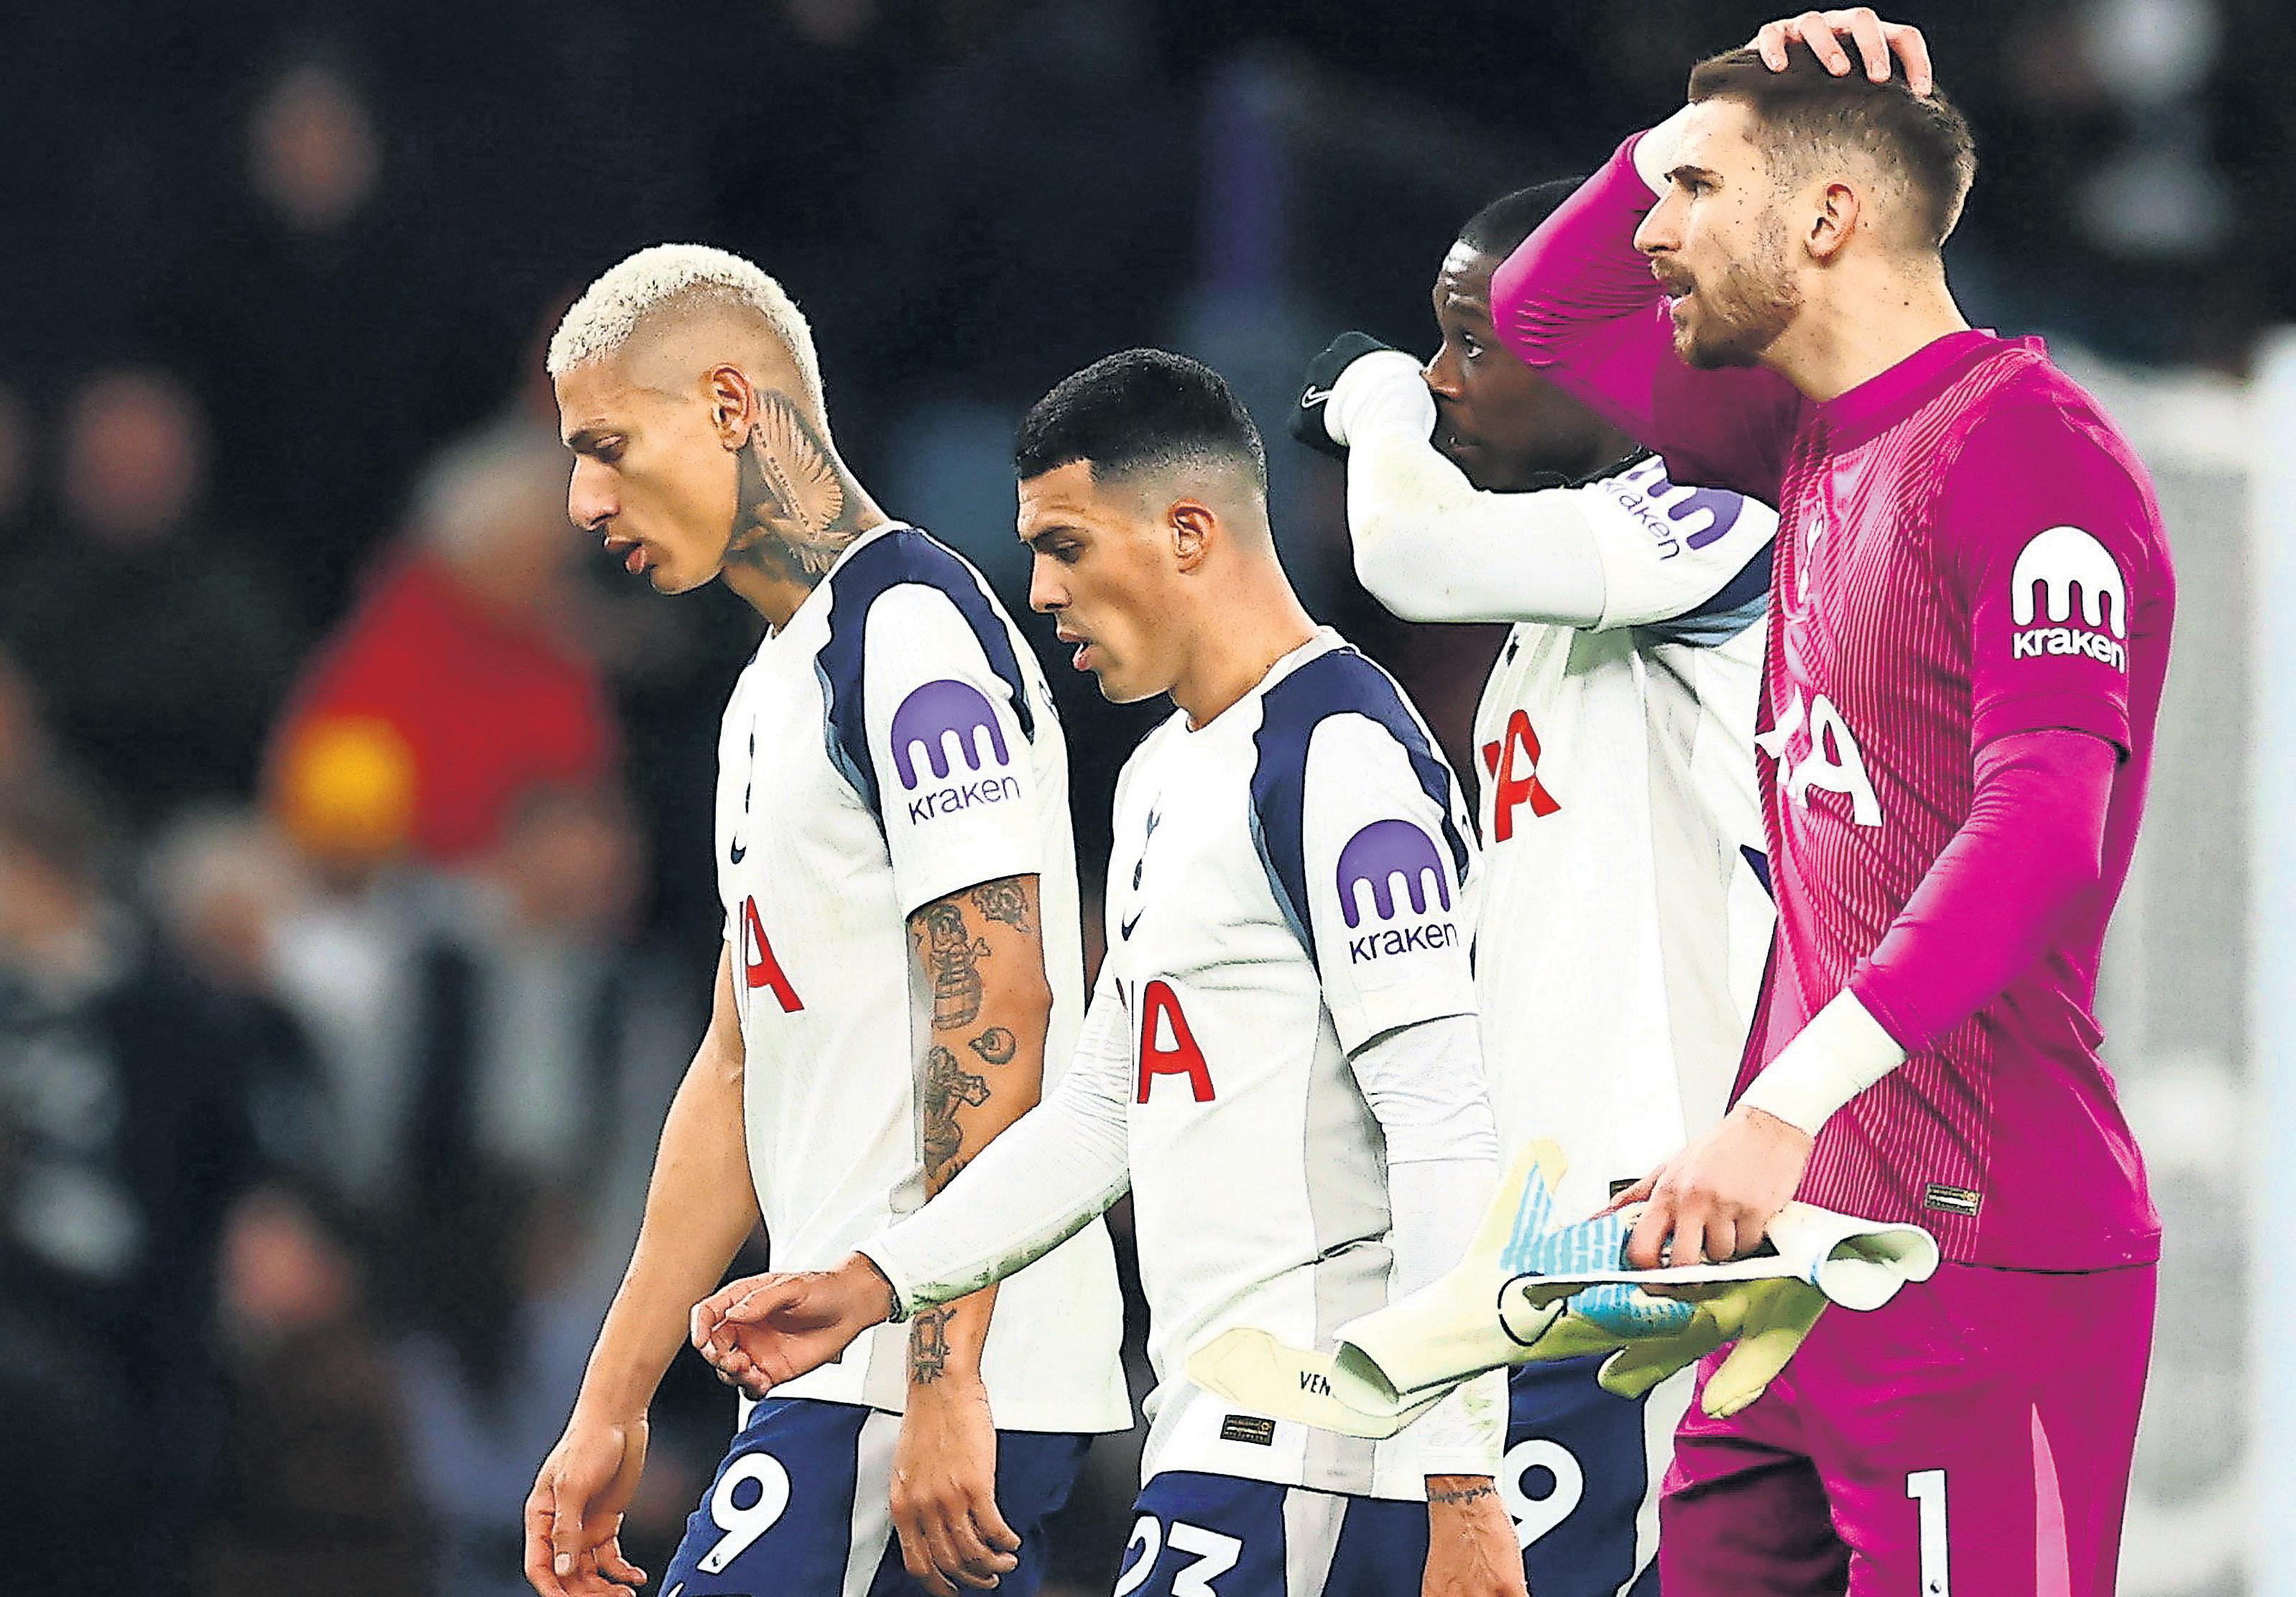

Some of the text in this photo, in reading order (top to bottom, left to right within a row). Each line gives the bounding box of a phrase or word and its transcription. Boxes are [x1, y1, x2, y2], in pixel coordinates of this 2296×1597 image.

[2013, 627, 2126, 674] kraken
[908, 775, 1020, 825] kraken
[1349, 923, 1460, 965] kraken
[696, 1452, 790, 1574] 9
[1503, 1439, 1584, 1551] 9
[1907, 1469, 1949, 1597] 1
[1113, 1515, 1243, 1597] 23
